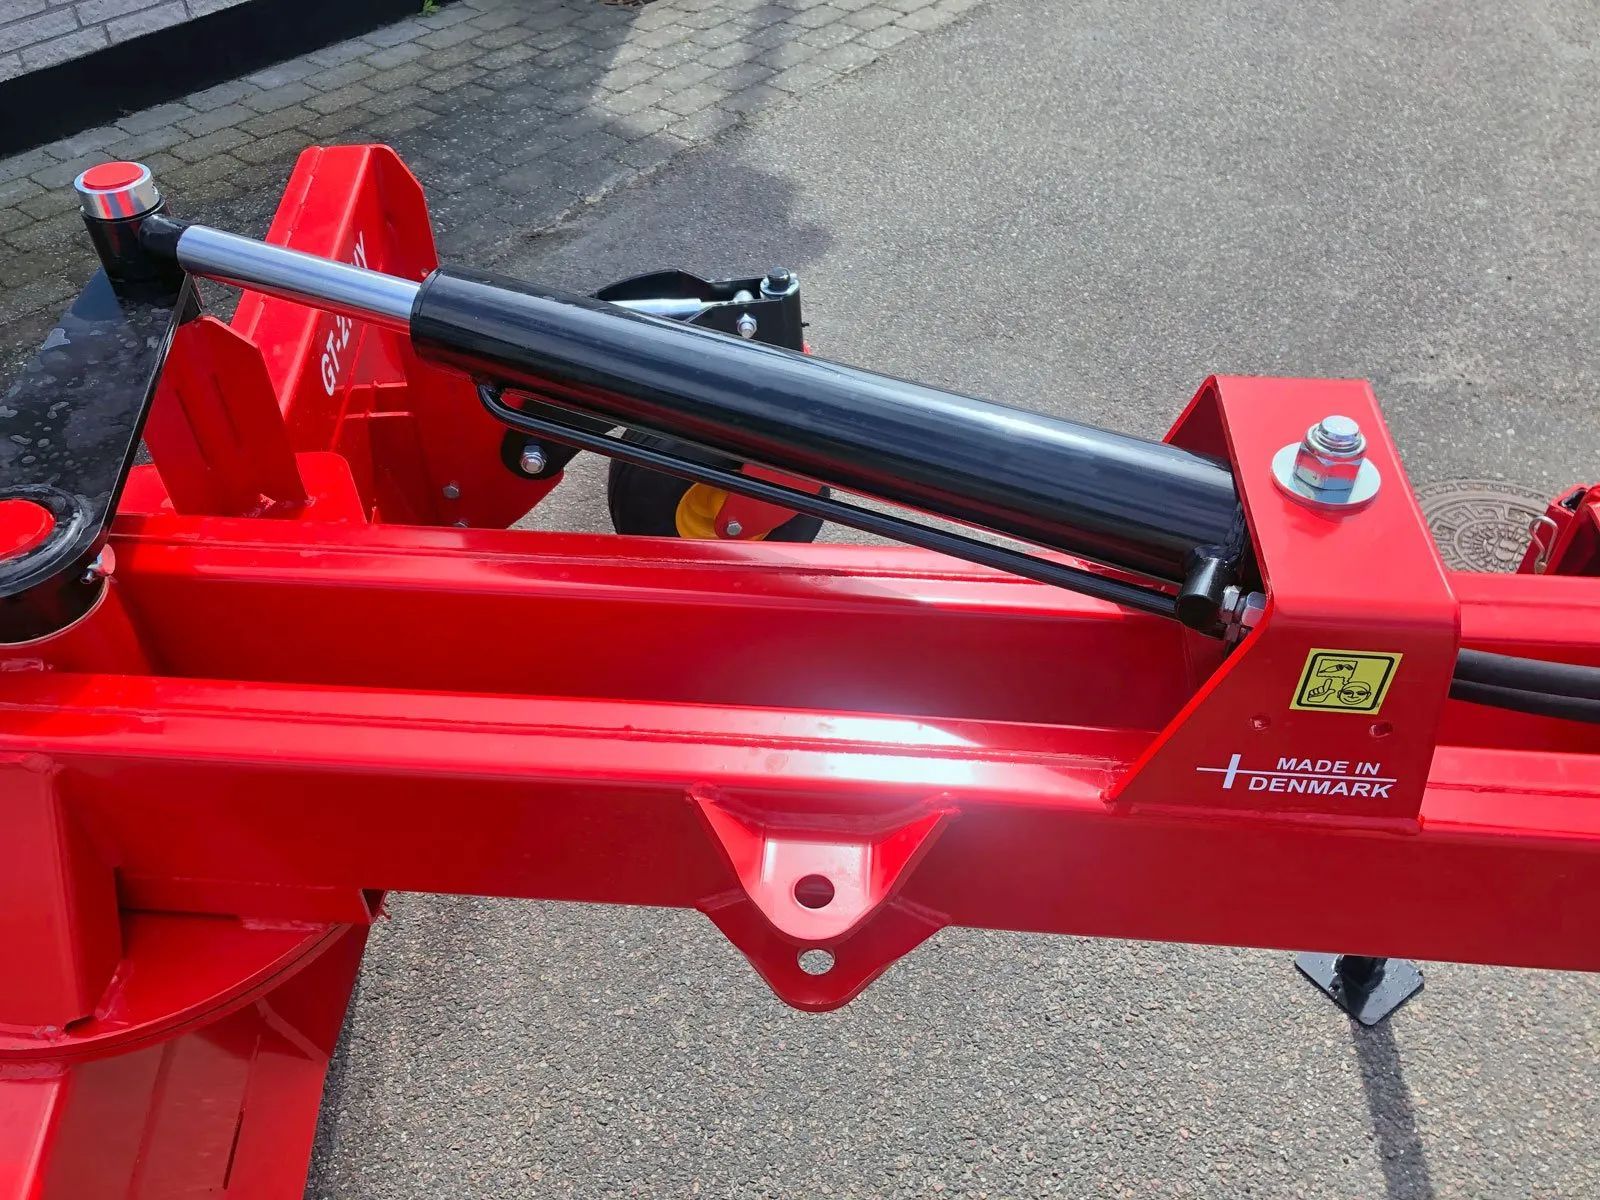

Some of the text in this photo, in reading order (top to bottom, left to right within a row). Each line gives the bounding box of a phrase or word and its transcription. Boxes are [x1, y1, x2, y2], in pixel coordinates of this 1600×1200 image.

[1276, 757, 1381, 775] MADE IN
[1248, 776, 1394, 798] DENMARK
